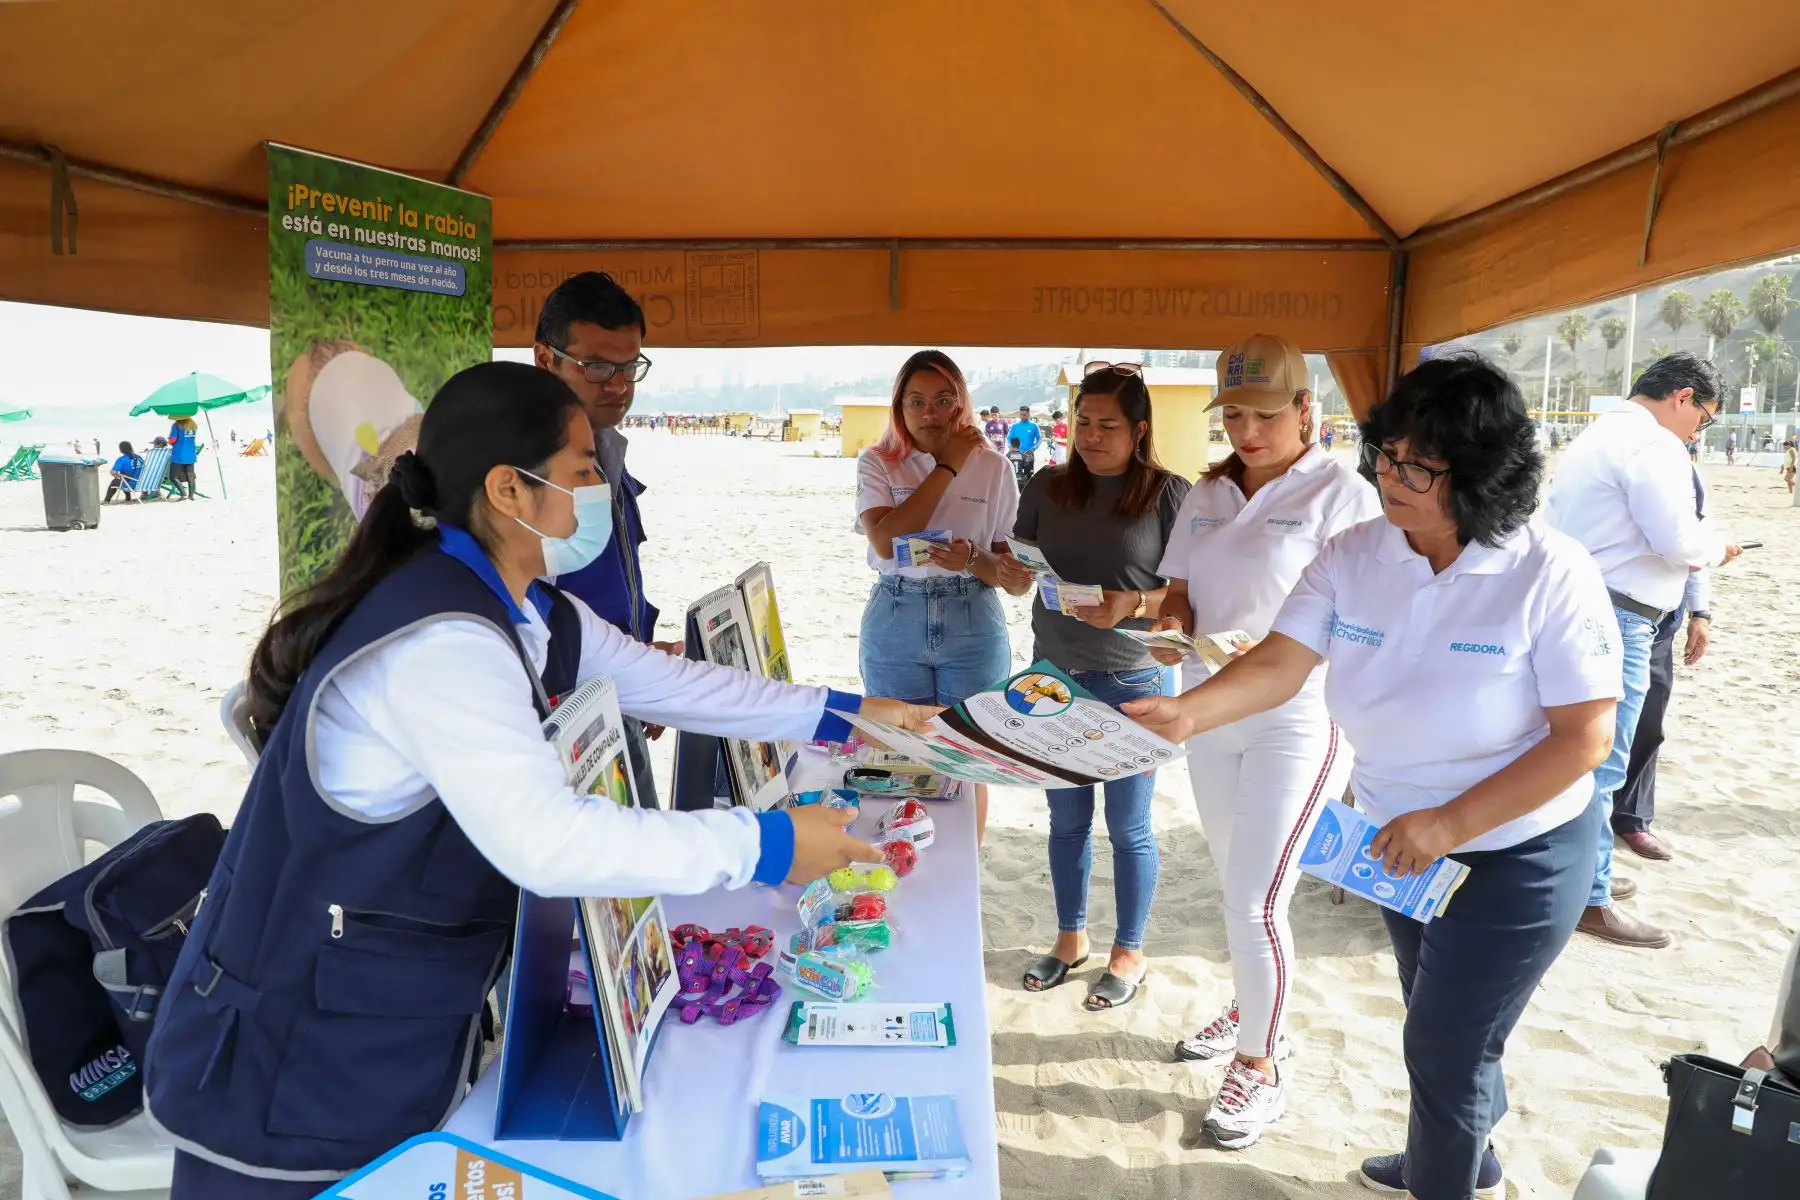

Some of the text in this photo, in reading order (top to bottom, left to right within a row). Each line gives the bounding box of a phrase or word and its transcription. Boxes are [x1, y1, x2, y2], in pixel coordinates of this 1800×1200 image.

[287, 183, 477, 240] ¡Prevenir la rabia
[282, 214, 481, 262] está en nuestras manos!
[314, 261, 458, 290] y desde los tres meses de nacido.
[315, 246, 457, 277] Vacuna a tu perro una vez al año
[1336, 628, 1383, 647] Chorrillos
[1450, 642, 1506, 656] REGIDORA
[1320, 832, 1335, 856] AVIAR
[69, 1044, 133, 1093] MINSA
[780, 1119, 792, 1144] AVIAR
